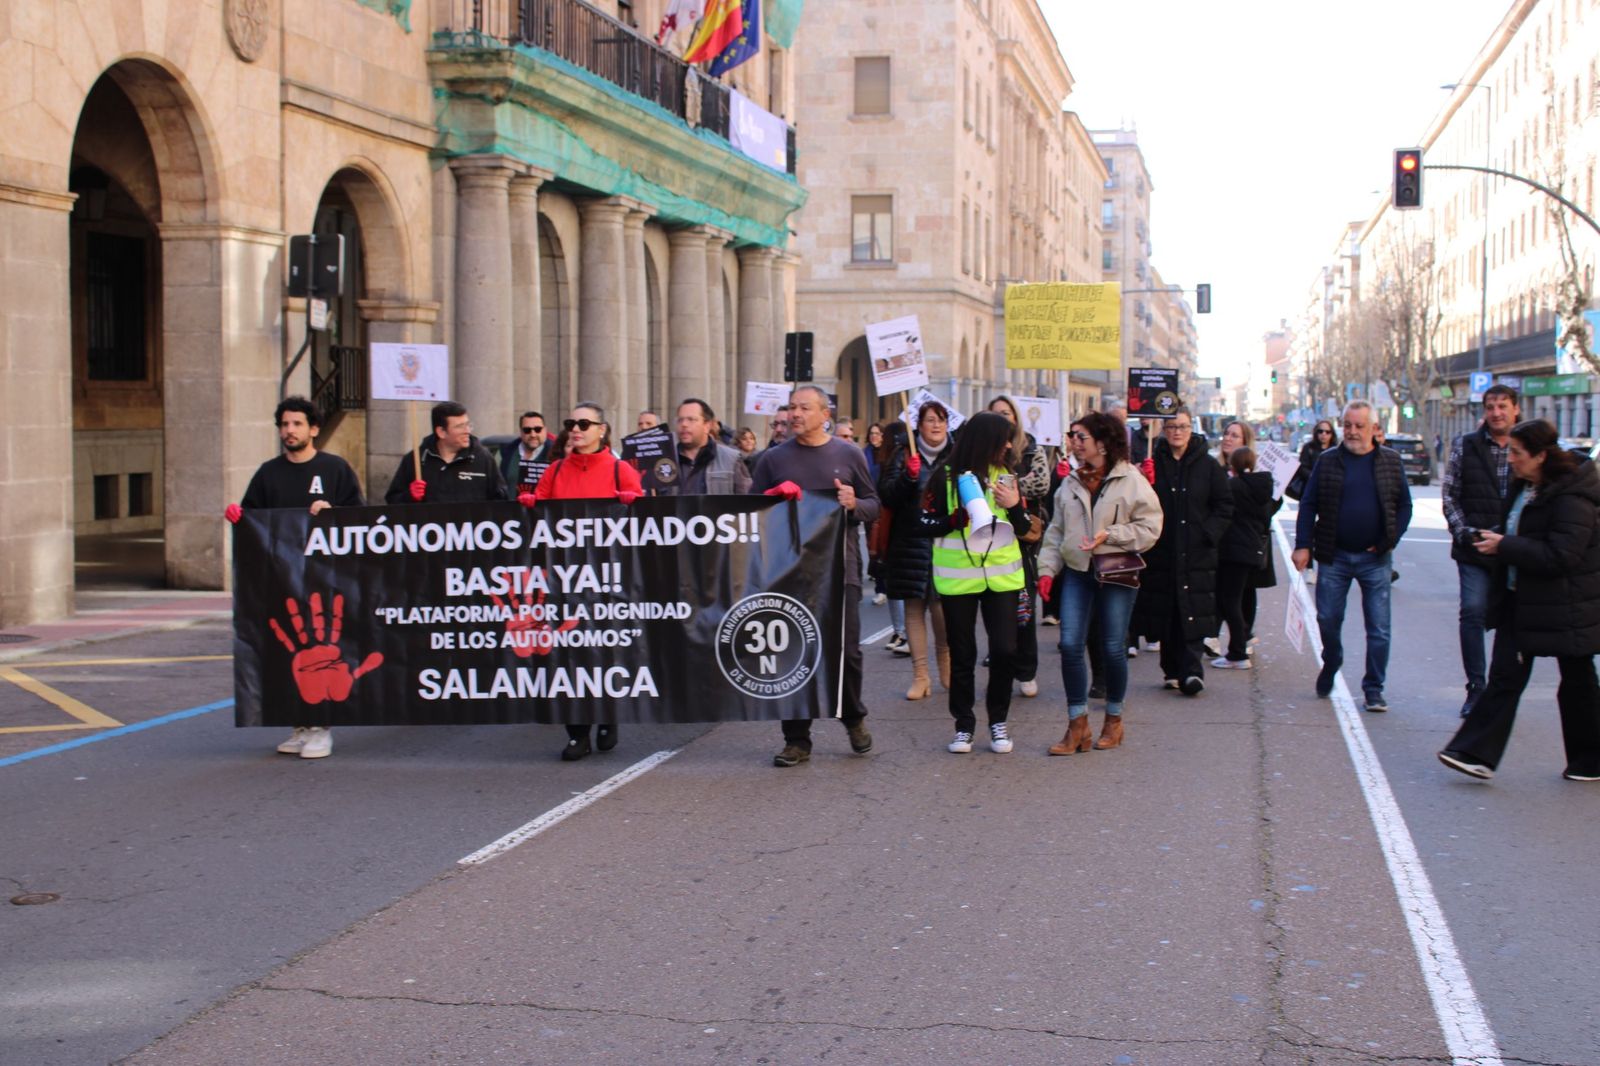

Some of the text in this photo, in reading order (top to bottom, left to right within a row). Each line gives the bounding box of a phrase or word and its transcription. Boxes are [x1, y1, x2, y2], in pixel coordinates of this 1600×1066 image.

[1072, 305, 1096, 323] DE
[1009, 344, 1025, 360] LA
[1475, 375, 1489, 391] P
[308, 475, 324, 494] A
[304, 512, 761, 556] AUTÓNOMOS ASFIXIADOS!!
[445, 562, 622, 597] BASTA YA!!
[375, 601, 692, 625] “PLATAFORMA POR LA DIGNIDAD
[720, 598, 816, 644] MANIFESTACION NACIONAL
[430, 624, 642, 650] DE LOS AUTÓNOMOS”
[744, 619, 789, 654] 30
[759, 654, 777, 675] N
[418, 666, 659, 701] SALAMANCA
[729, 665, 810, 694] DE AUTONOMOS
